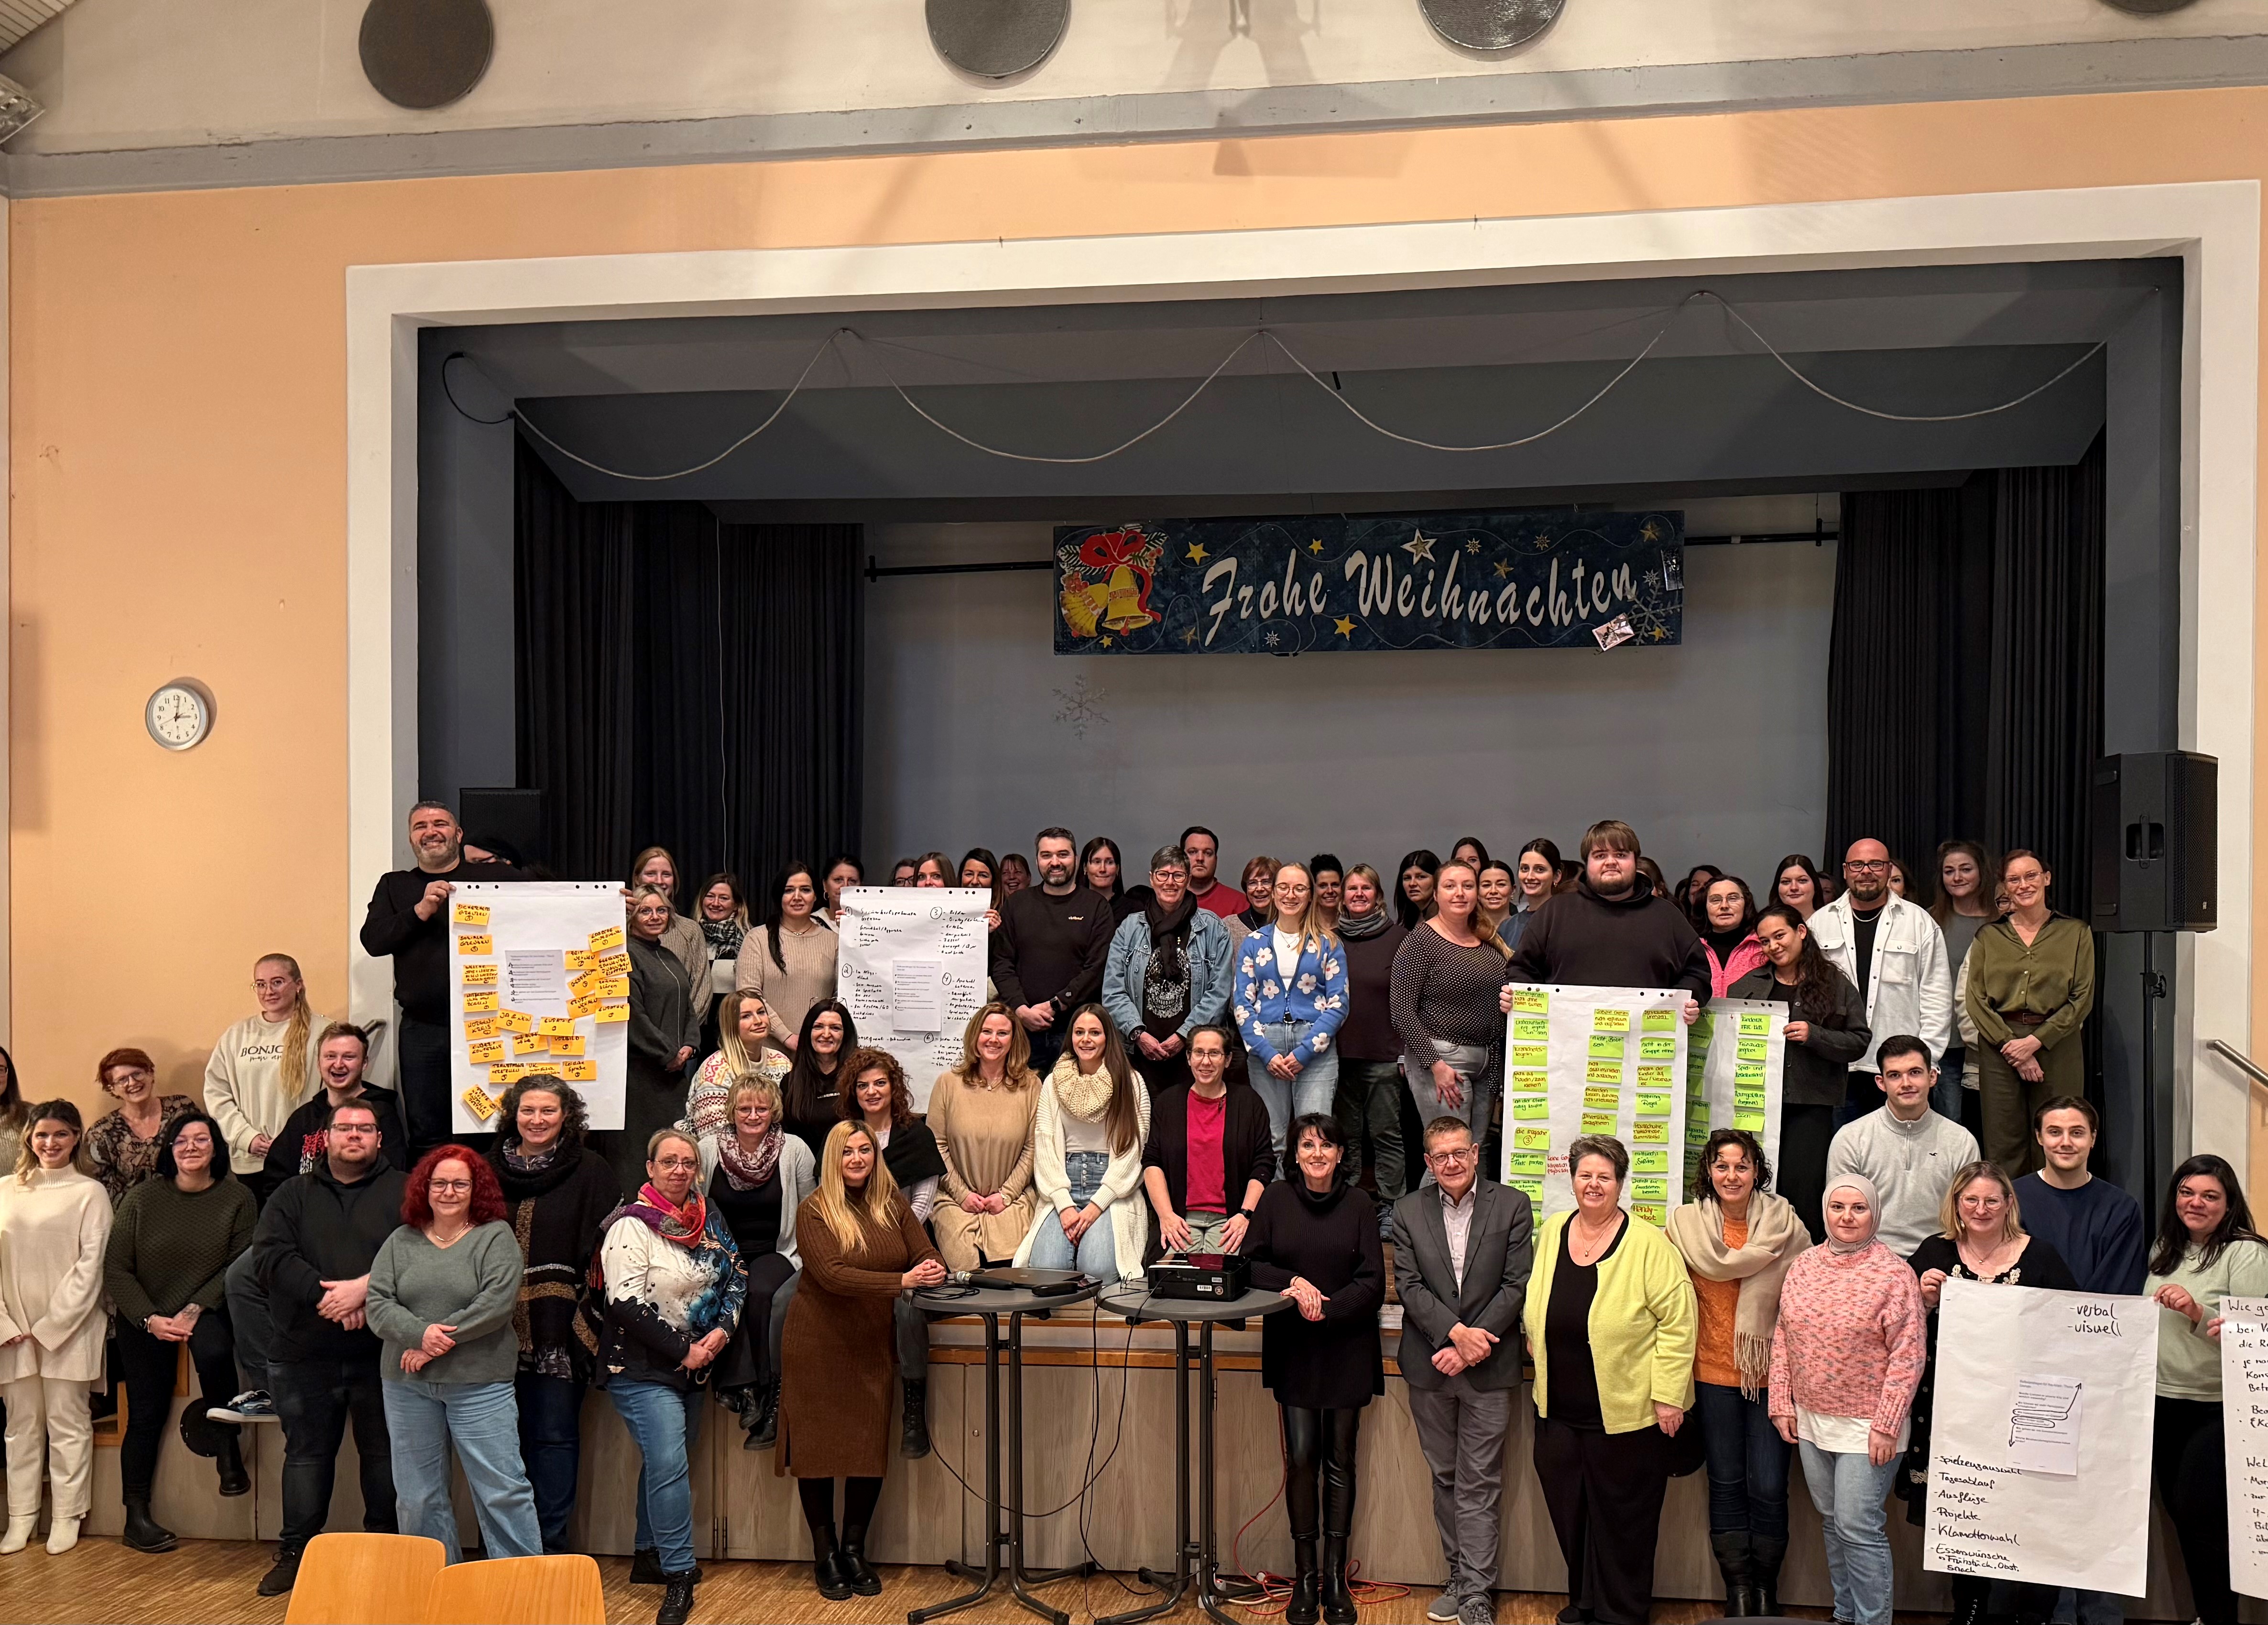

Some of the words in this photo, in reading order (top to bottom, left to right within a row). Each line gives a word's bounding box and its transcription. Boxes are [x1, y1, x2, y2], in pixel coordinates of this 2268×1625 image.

[1201, 548, 1327, 646] Frohe
[1345, 550, 1637, 626] Weihnachten
[2228, 1299, 2251, 1311] Wie
[2237, 1323, 2253, 1333] bei
[2239, 1340, 2253, 1348] die
